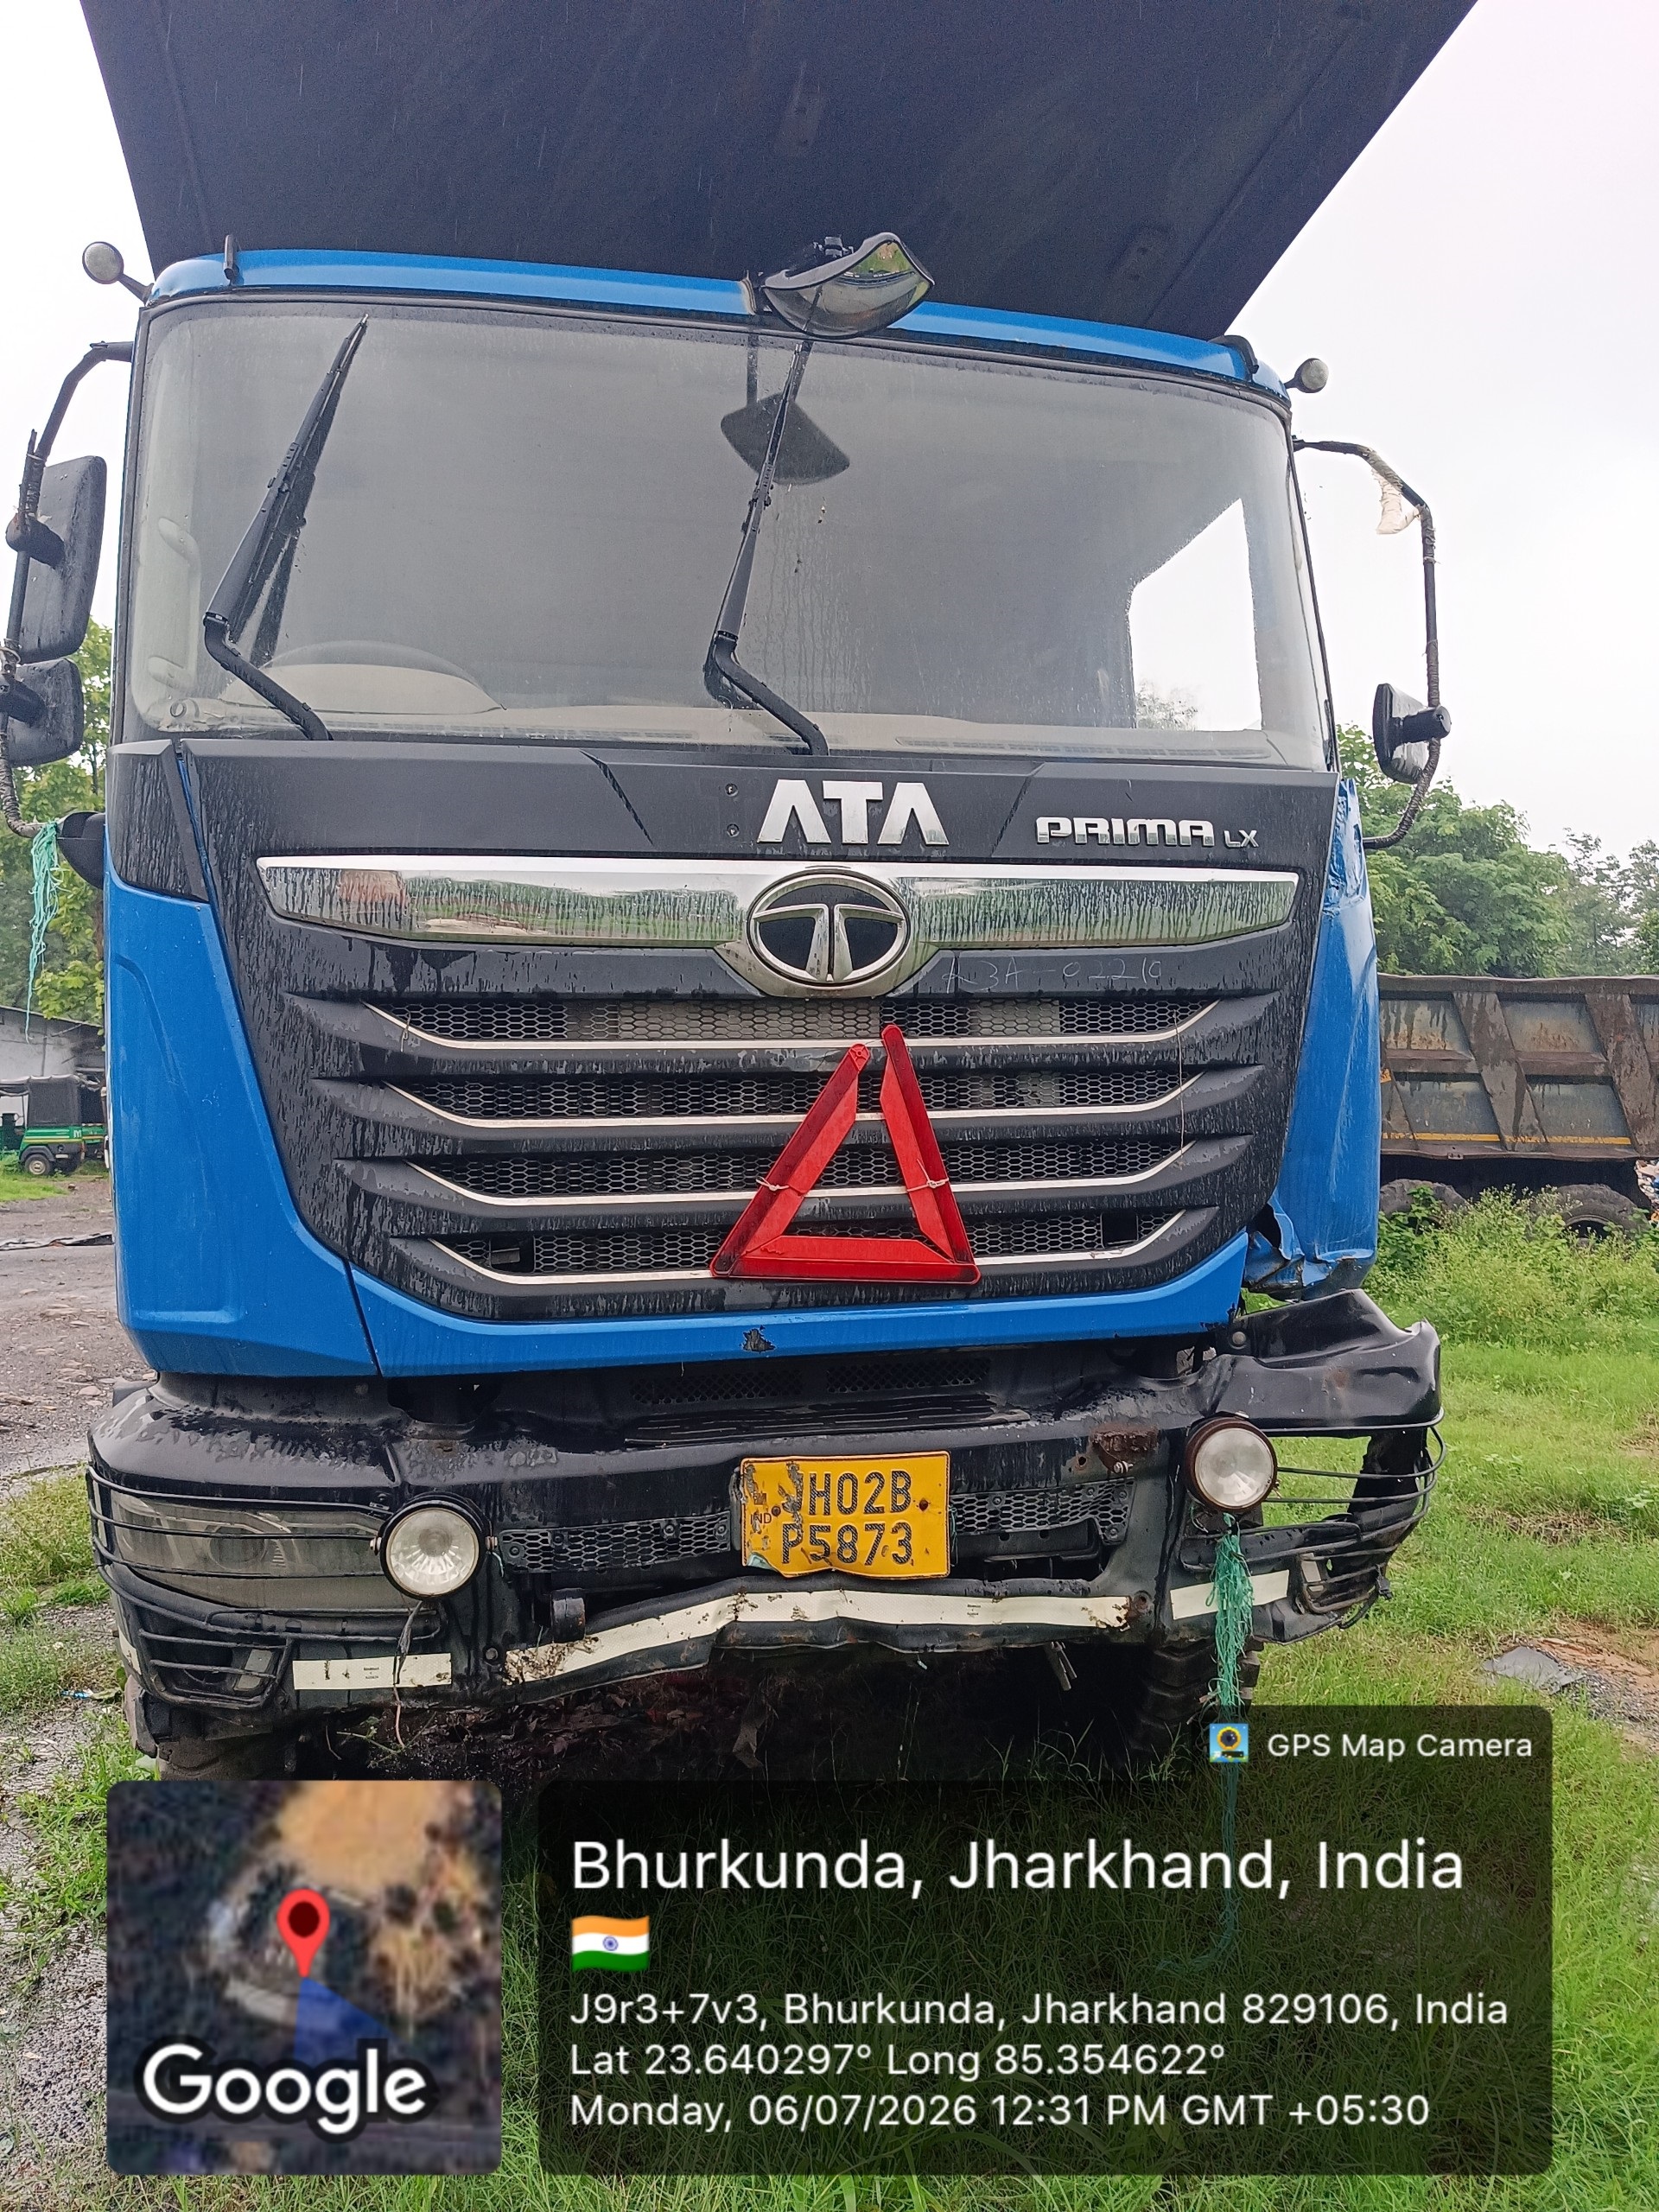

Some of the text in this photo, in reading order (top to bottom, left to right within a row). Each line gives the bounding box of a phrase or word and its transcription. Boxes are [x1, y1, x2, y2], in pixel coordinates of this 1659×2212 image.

[1036, 816, 1259, 848] PRIMA LX
[750, 1512, 772, 1525] IND
[781, 1522, 912, 1566] P5873
